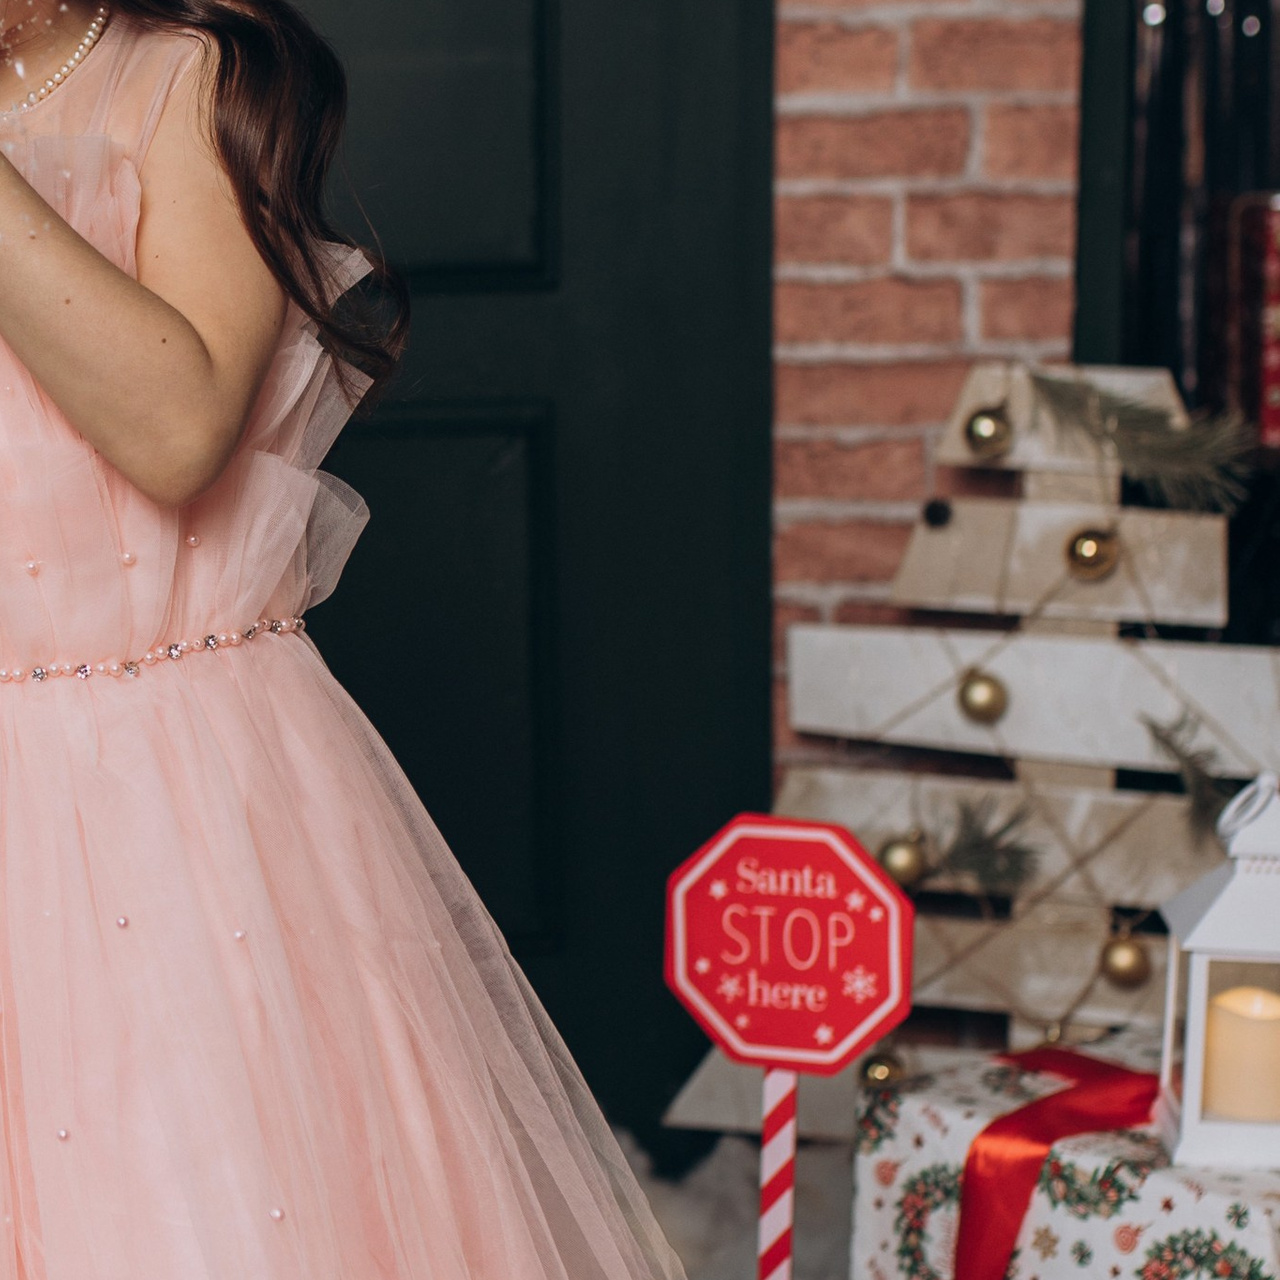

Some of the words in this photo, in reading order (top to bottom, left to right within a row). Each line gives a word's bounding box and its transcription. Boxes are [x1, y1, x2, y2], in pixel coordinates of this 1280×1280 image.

[736, 857, 837, 899] Santa
[721, 904, 856, 970] STOP
[748, 970, 828, 1012] here
